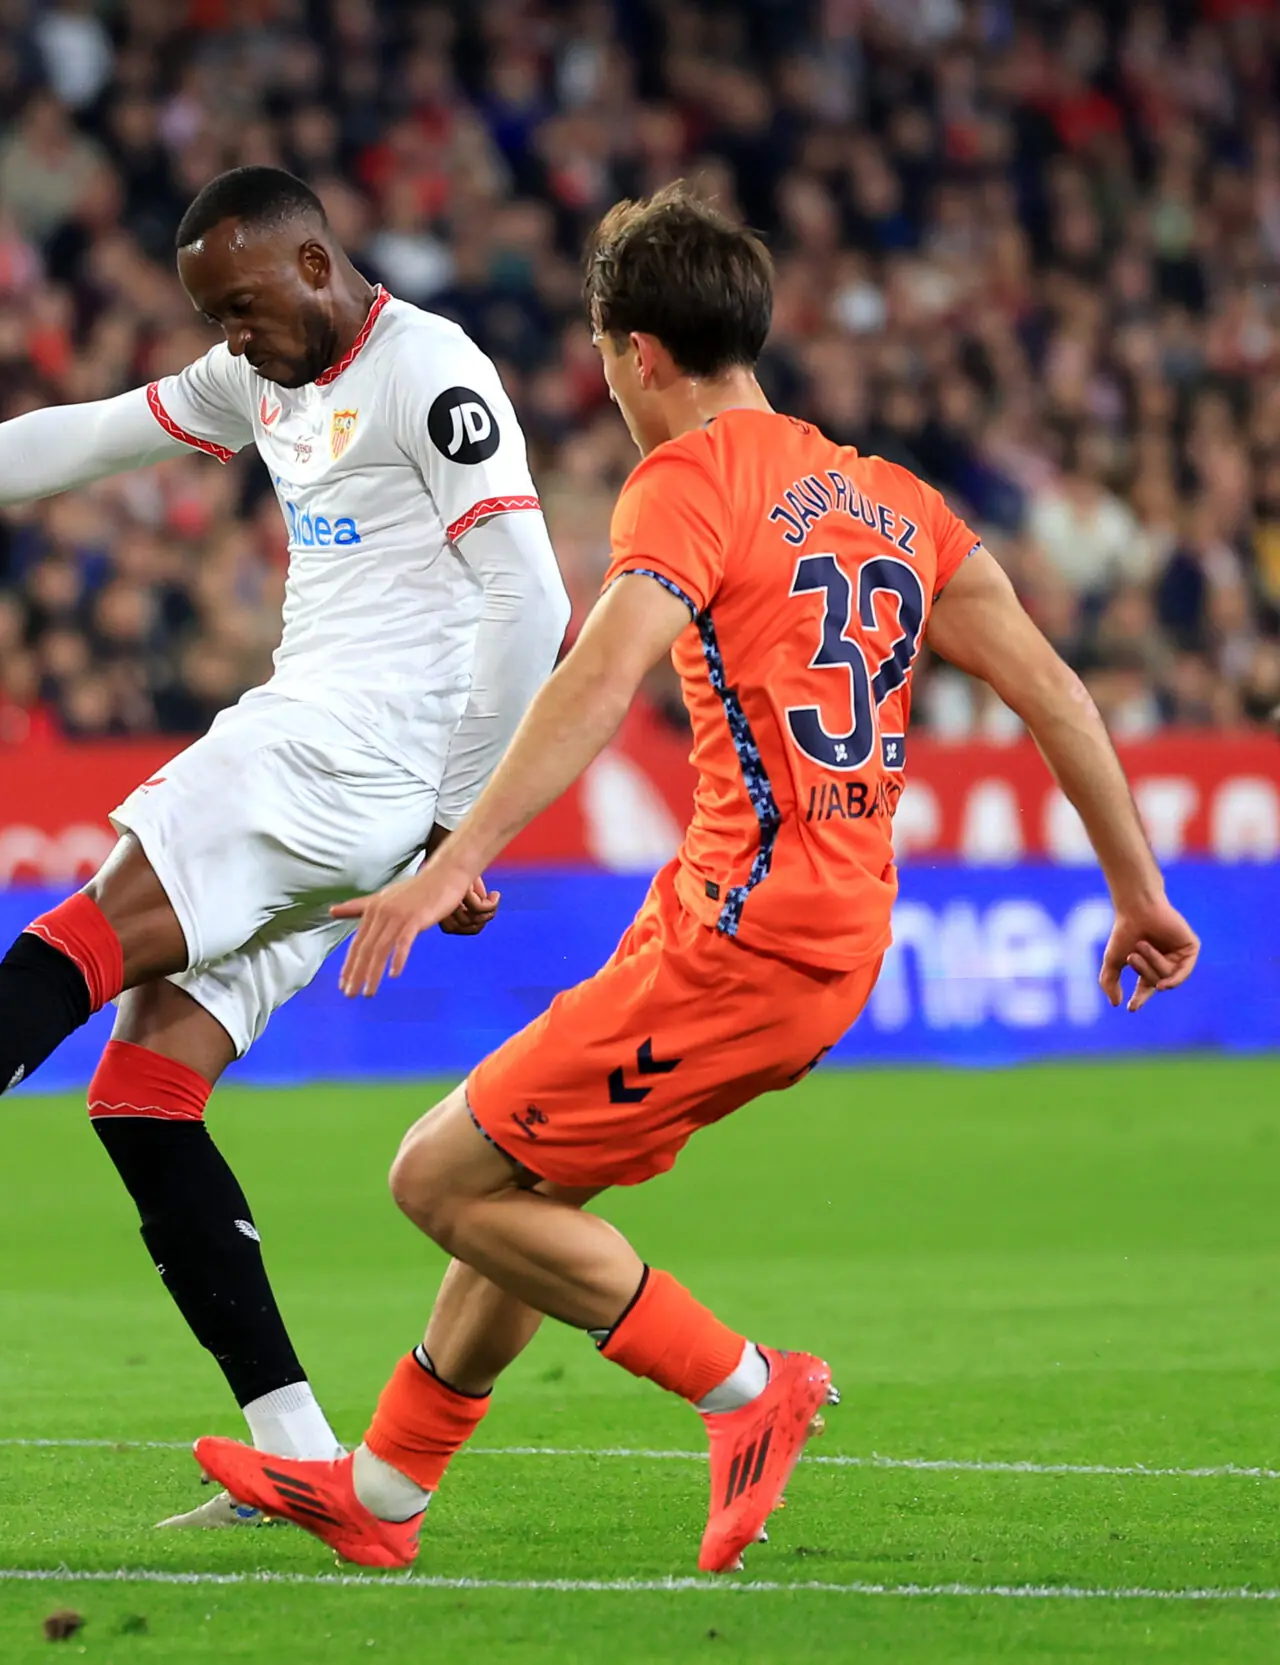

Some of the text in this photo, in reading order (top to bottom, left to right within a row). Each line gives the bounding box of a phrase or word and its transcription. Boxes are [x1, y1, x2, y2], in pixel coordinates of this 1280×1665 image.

[447, 401, 492, 455] JD
[286, 501, 361, 546] idea
[768, 474, 834, 546] JAVI
[784, 553, 925, 772] 32
